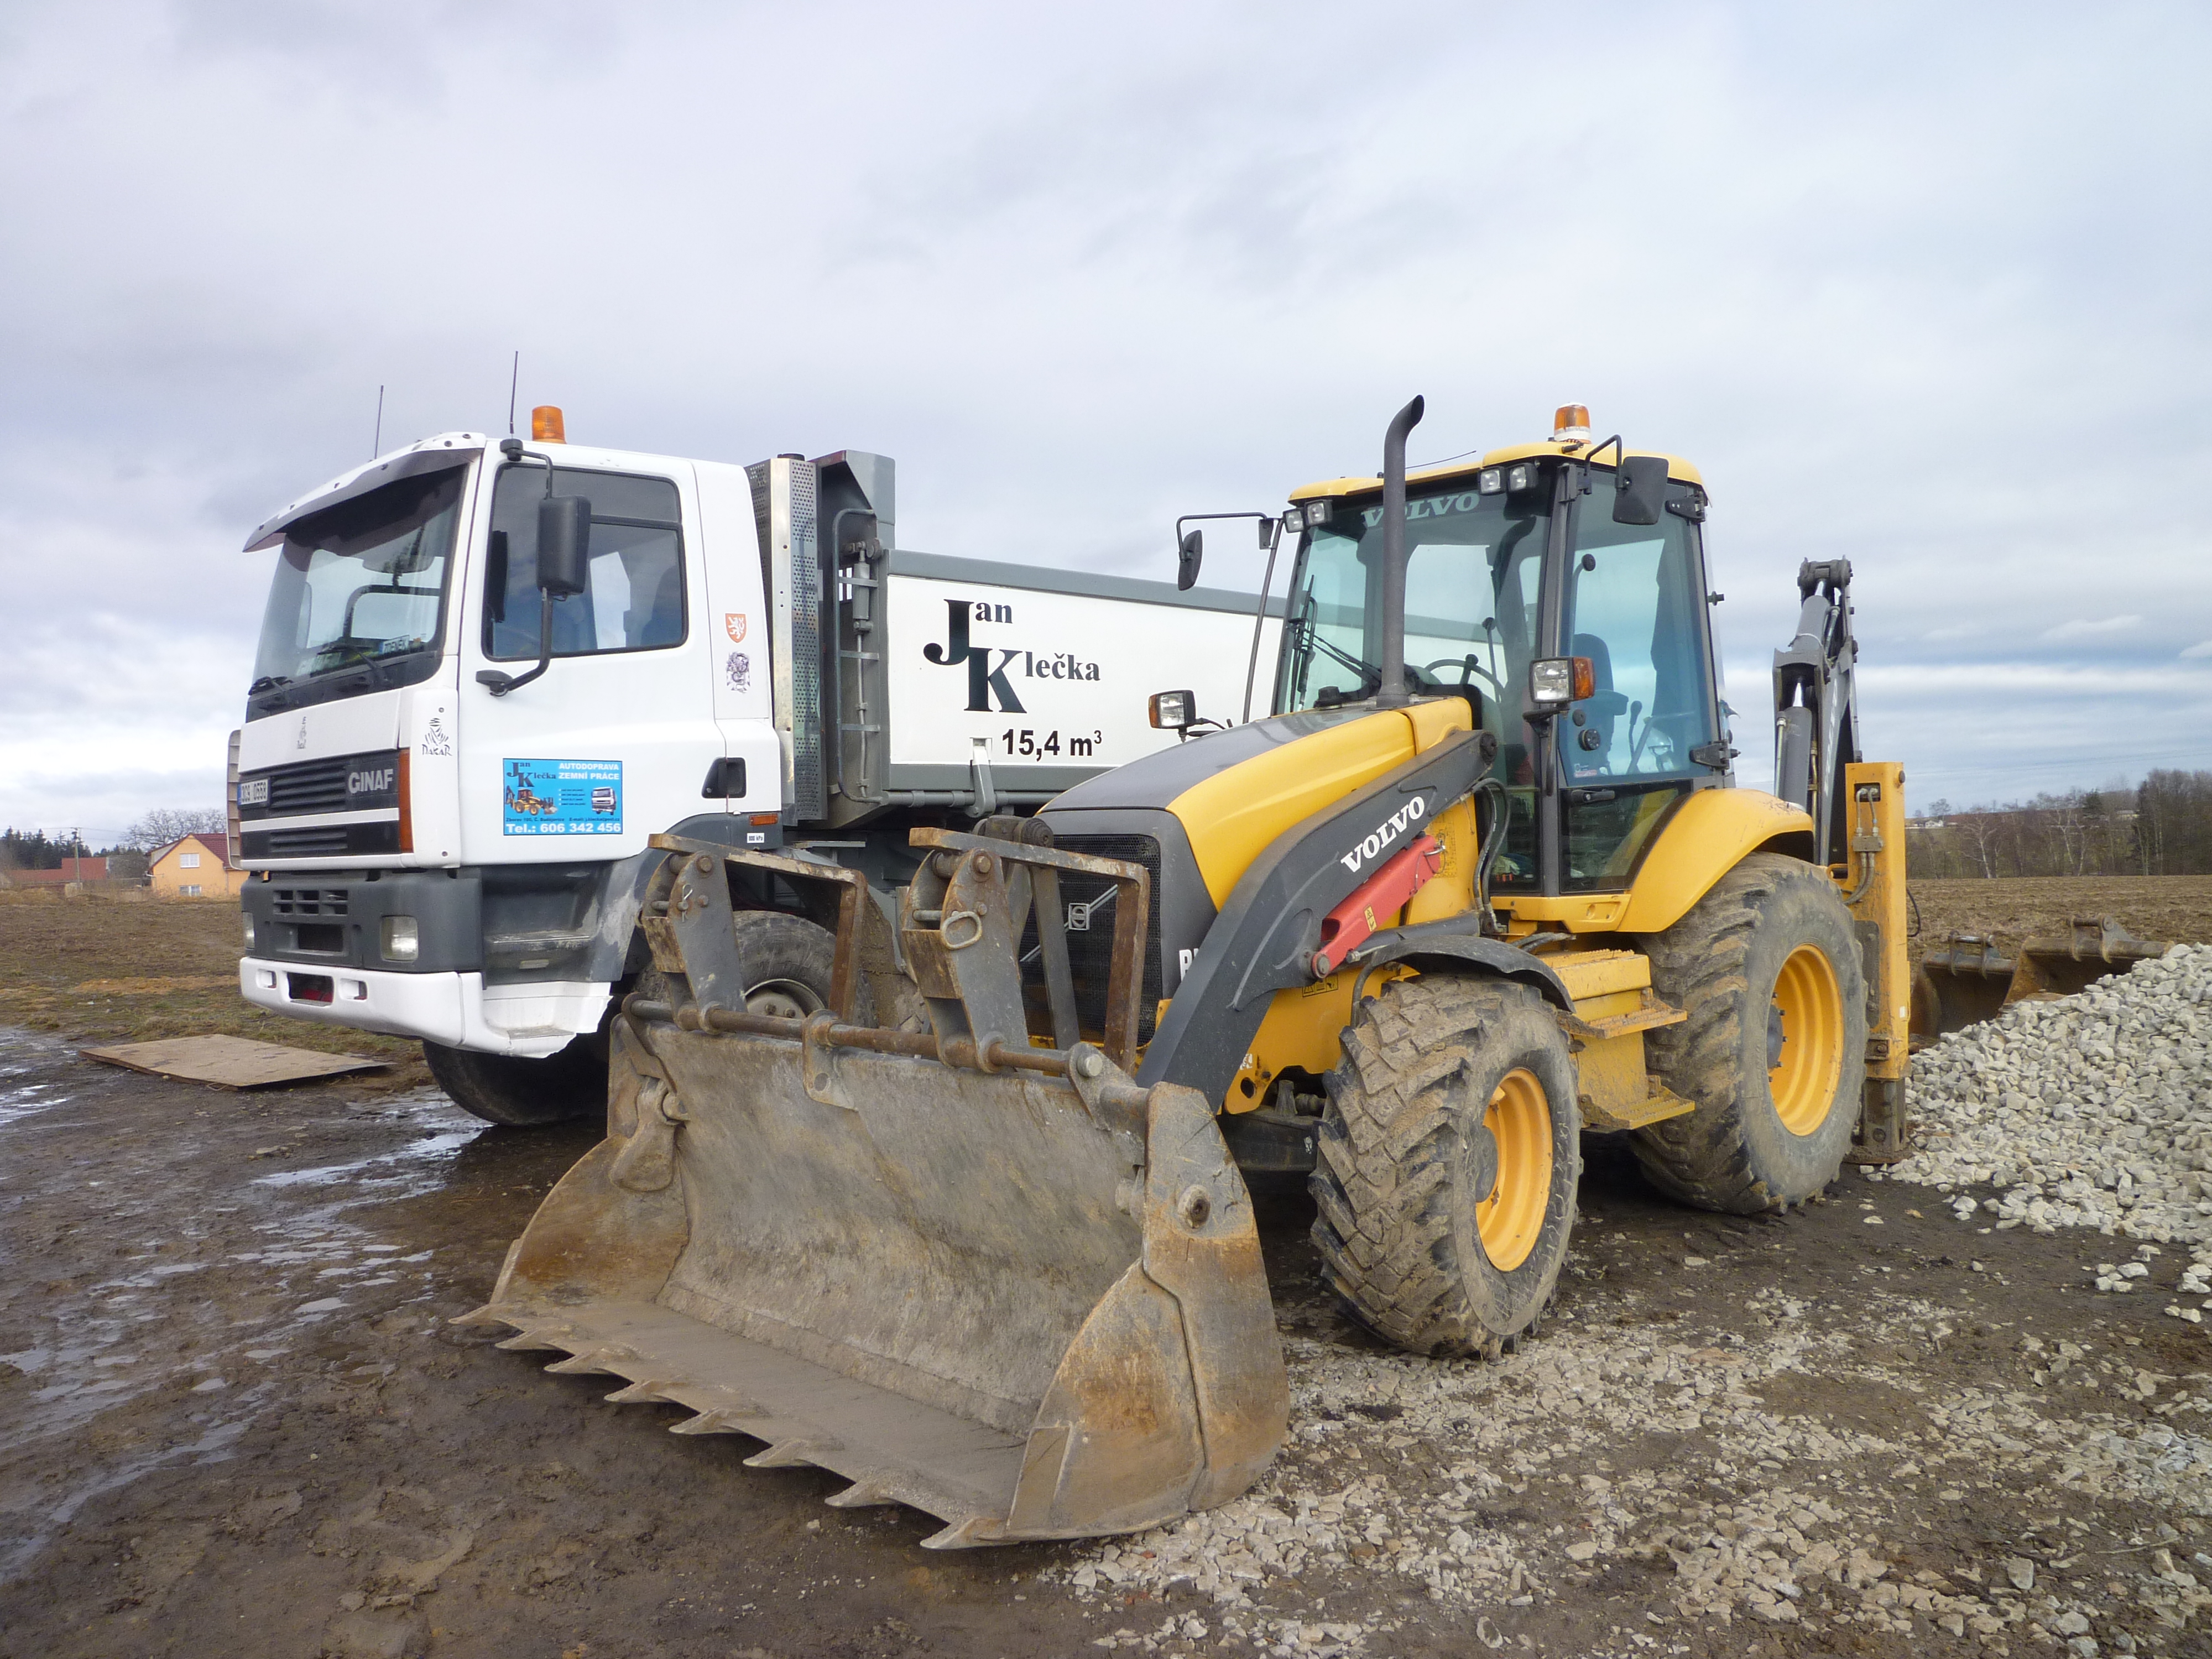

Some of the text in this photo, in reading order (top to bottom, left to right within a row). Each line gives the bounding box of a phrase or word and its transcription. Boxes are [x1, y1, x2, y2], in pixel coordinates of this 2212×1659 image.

[1361, 493, 1480, 528] VLVO
[923, 599, 1013, 666] Jan
[421, 743, 452, 757] DAKAR
[1001, 728, 1060, 761] 15,4
[348, 769, 394, 794] GINAF
[590, 771, 620, 780] PRÁCE
[506, 822, 621, 833] Tel.: 606 342 456
[1340, 796, 1426, 873] VOLVO
